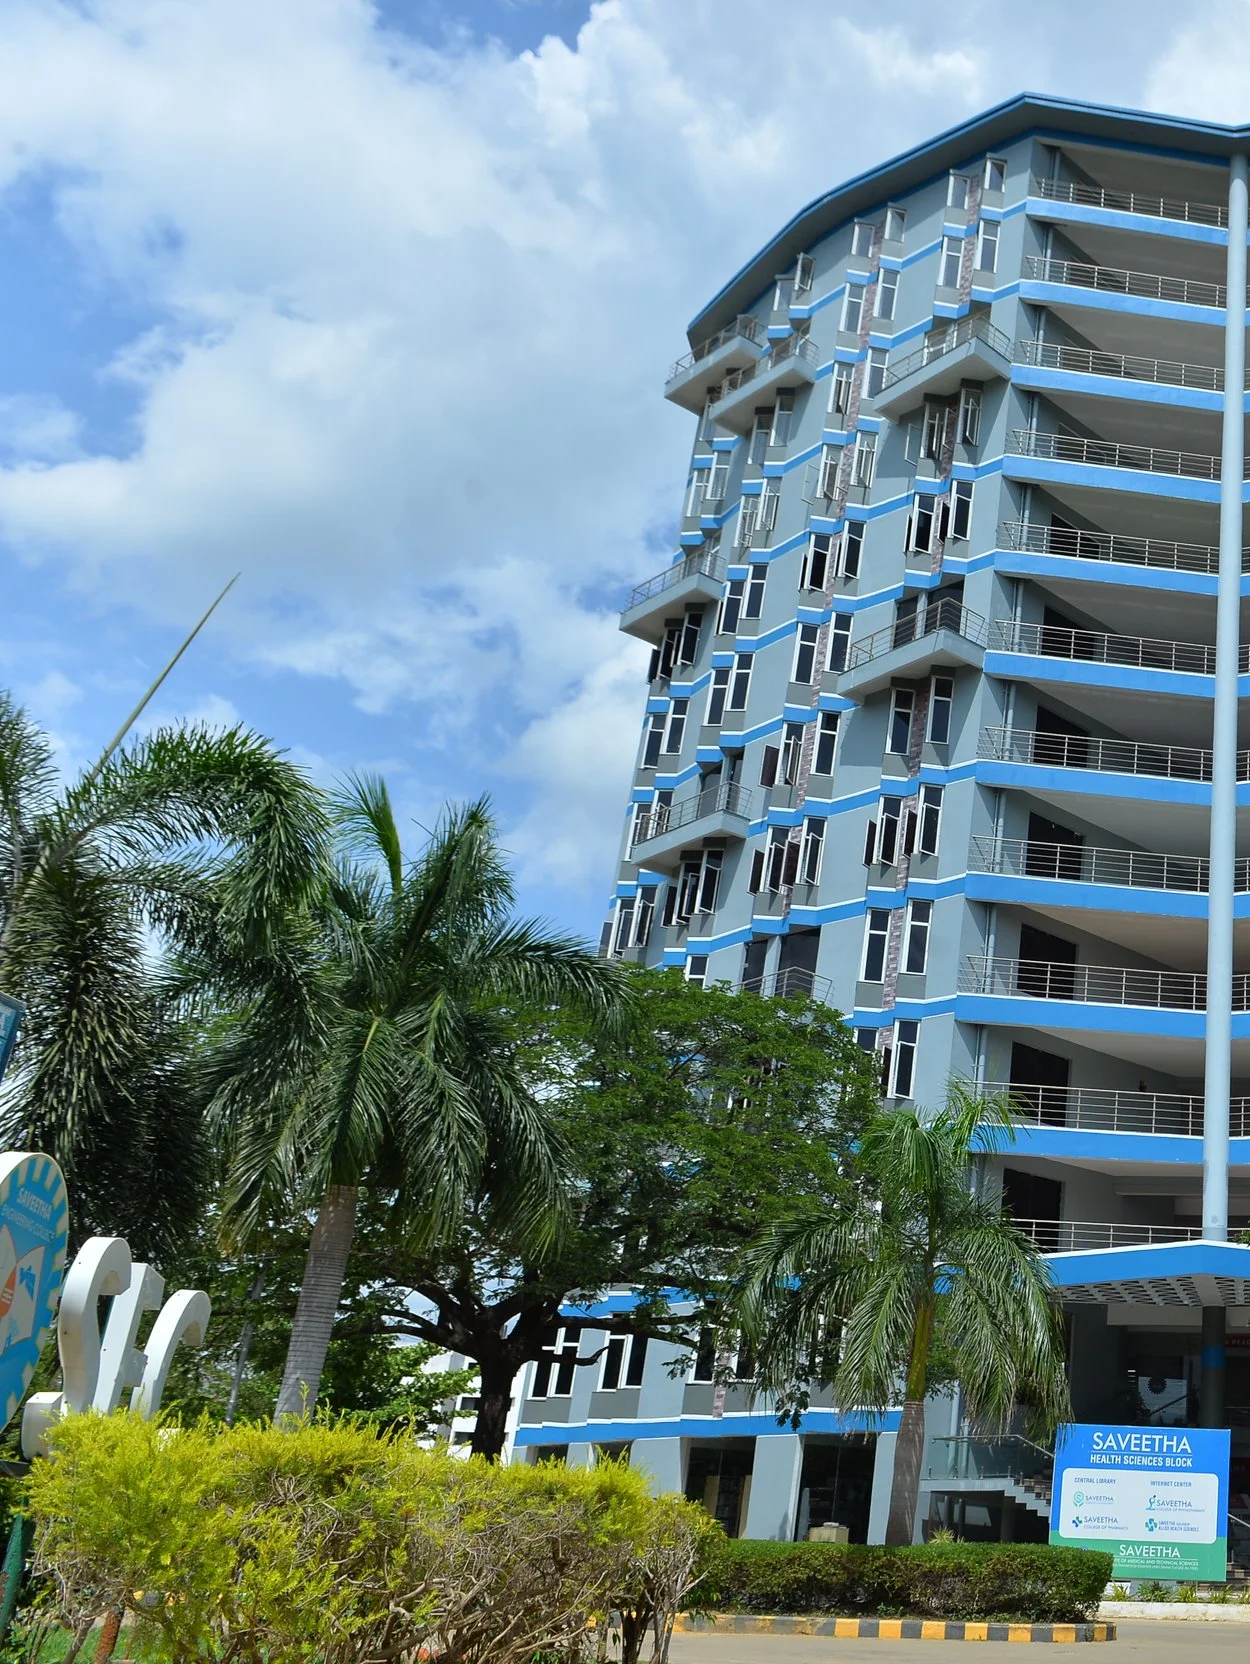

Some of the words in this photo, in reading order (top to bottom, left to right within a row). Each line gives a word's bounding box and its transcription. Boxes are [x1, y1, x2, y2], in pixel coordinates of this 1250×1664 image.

[16, 1187, 52, 1221] SAVEETHA
[1092, 1431, 1192, 1453] SAVEETHA
[1090, 1454, 1121, 1465] HEALTH
[1123, 1456, 1163, 1467] SCIENCES
[1165, 1457, 1193, 1468] BLOCK
[1156, 1499, 1193, 1508] SAVEETHA
[1084, 1516, 1118, 1524] SAVEETHA
[1119, 1544, 1181, 1558] SAVEETHA
